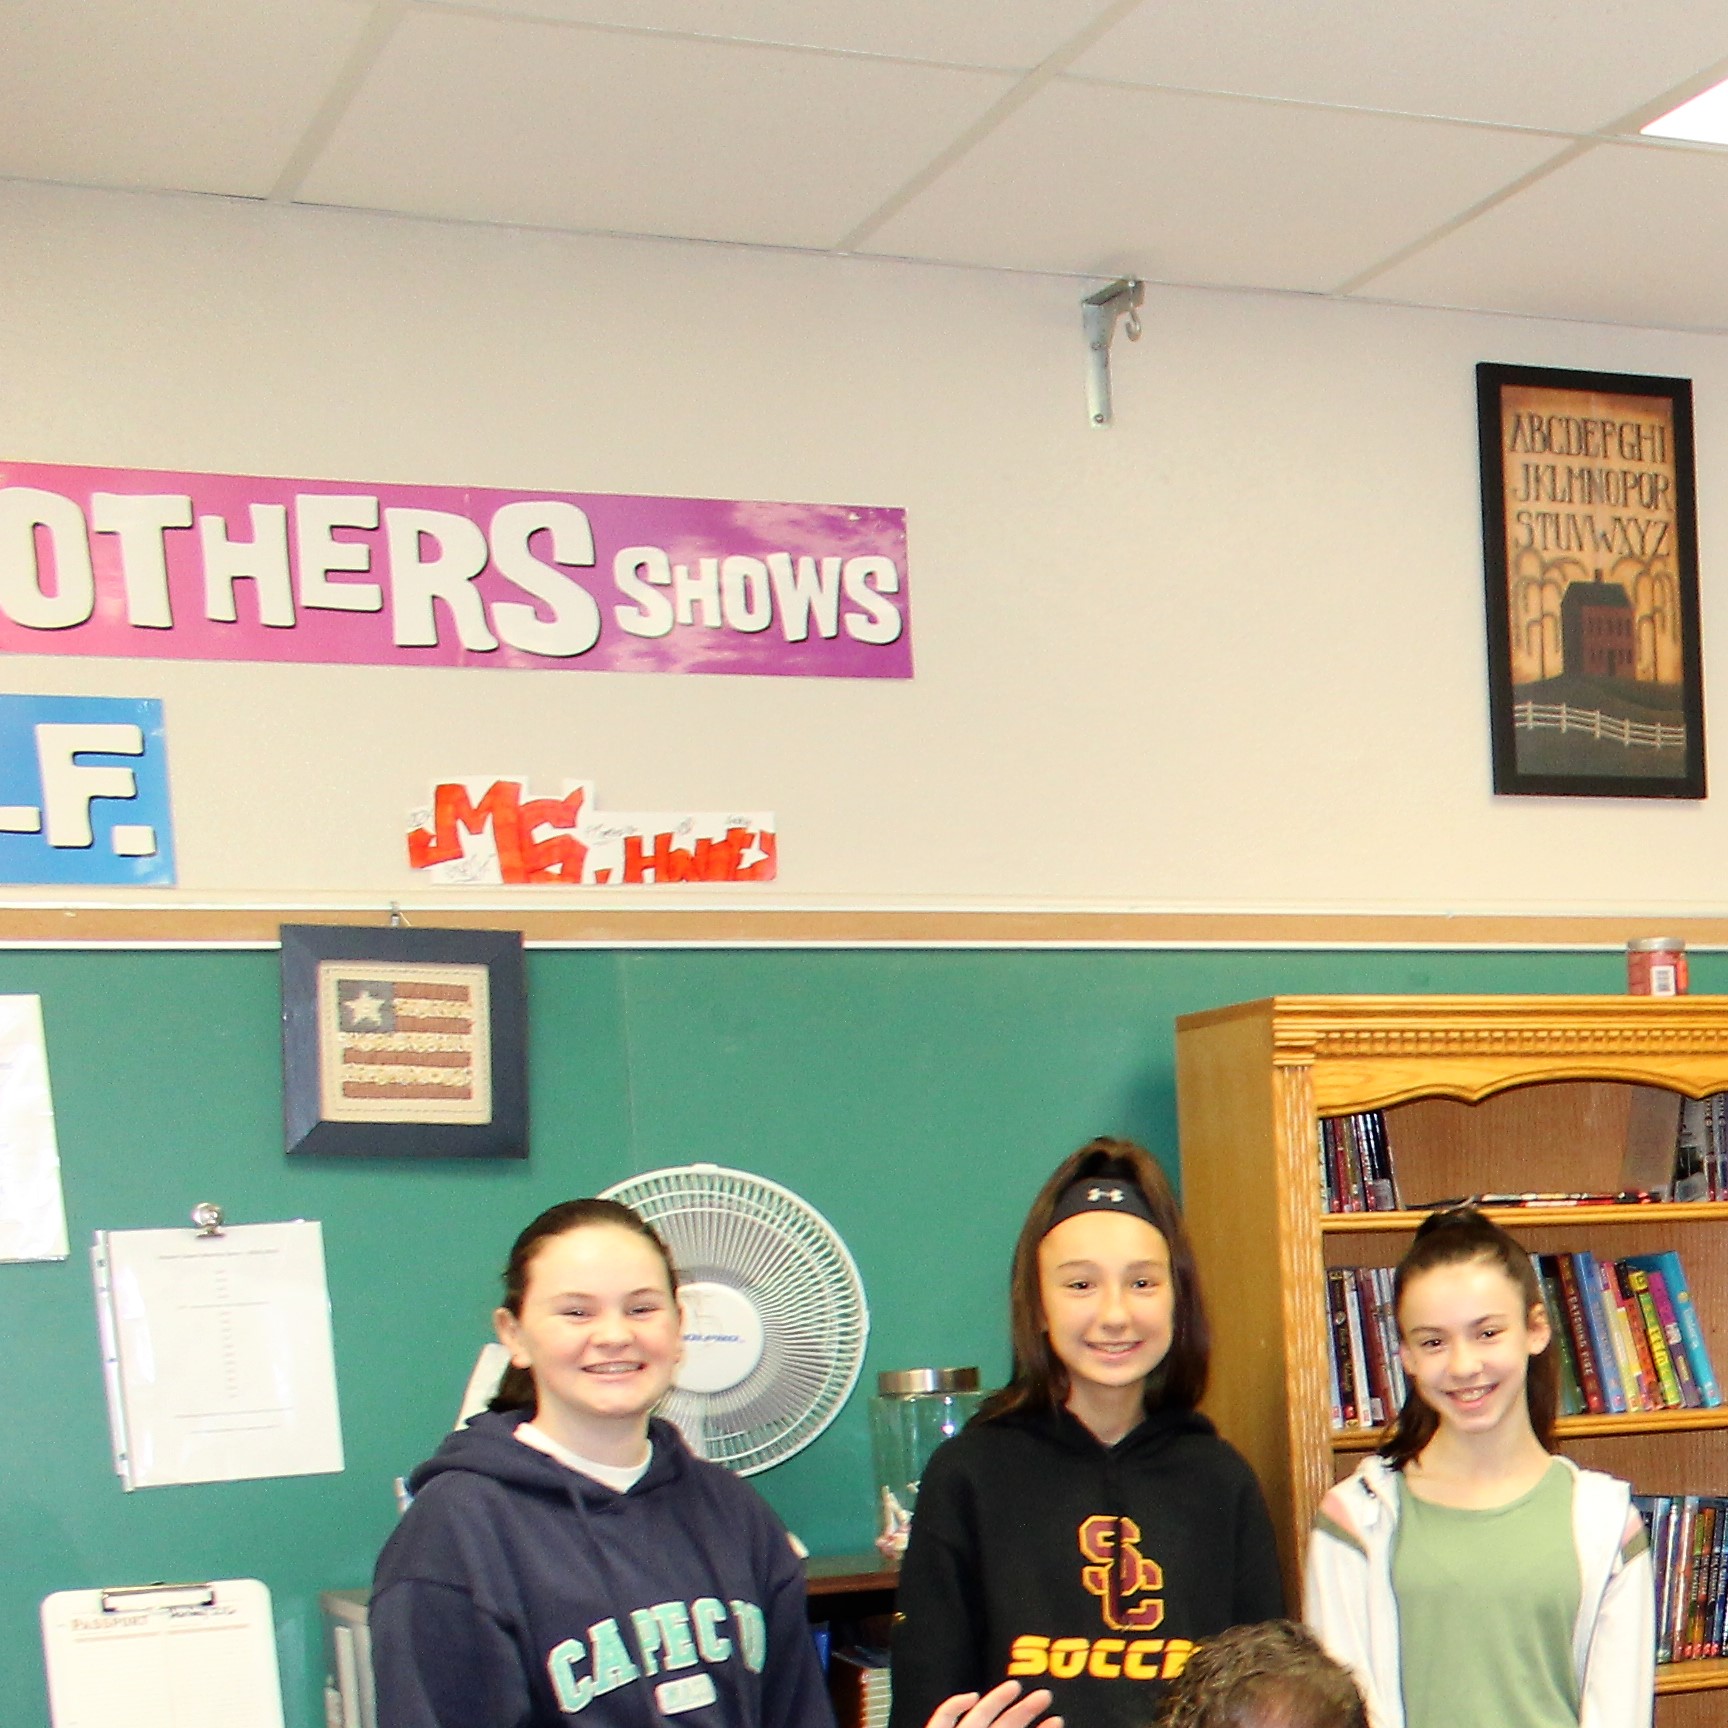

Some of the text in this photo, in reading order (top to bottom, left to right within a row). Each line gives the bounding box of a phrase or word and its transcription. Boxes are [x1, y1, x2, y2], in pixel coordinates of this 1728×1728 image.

[1510, 411, 1668, 464] ABCDEFGHI
[1511, 461, 1672, 512] JKLMNOPQR
[1516, 510, 1671, 558] STUVWXYZ
[613, 545, 902, 646] SHOWS
[547, 1608, 698, 1714] CAPE
